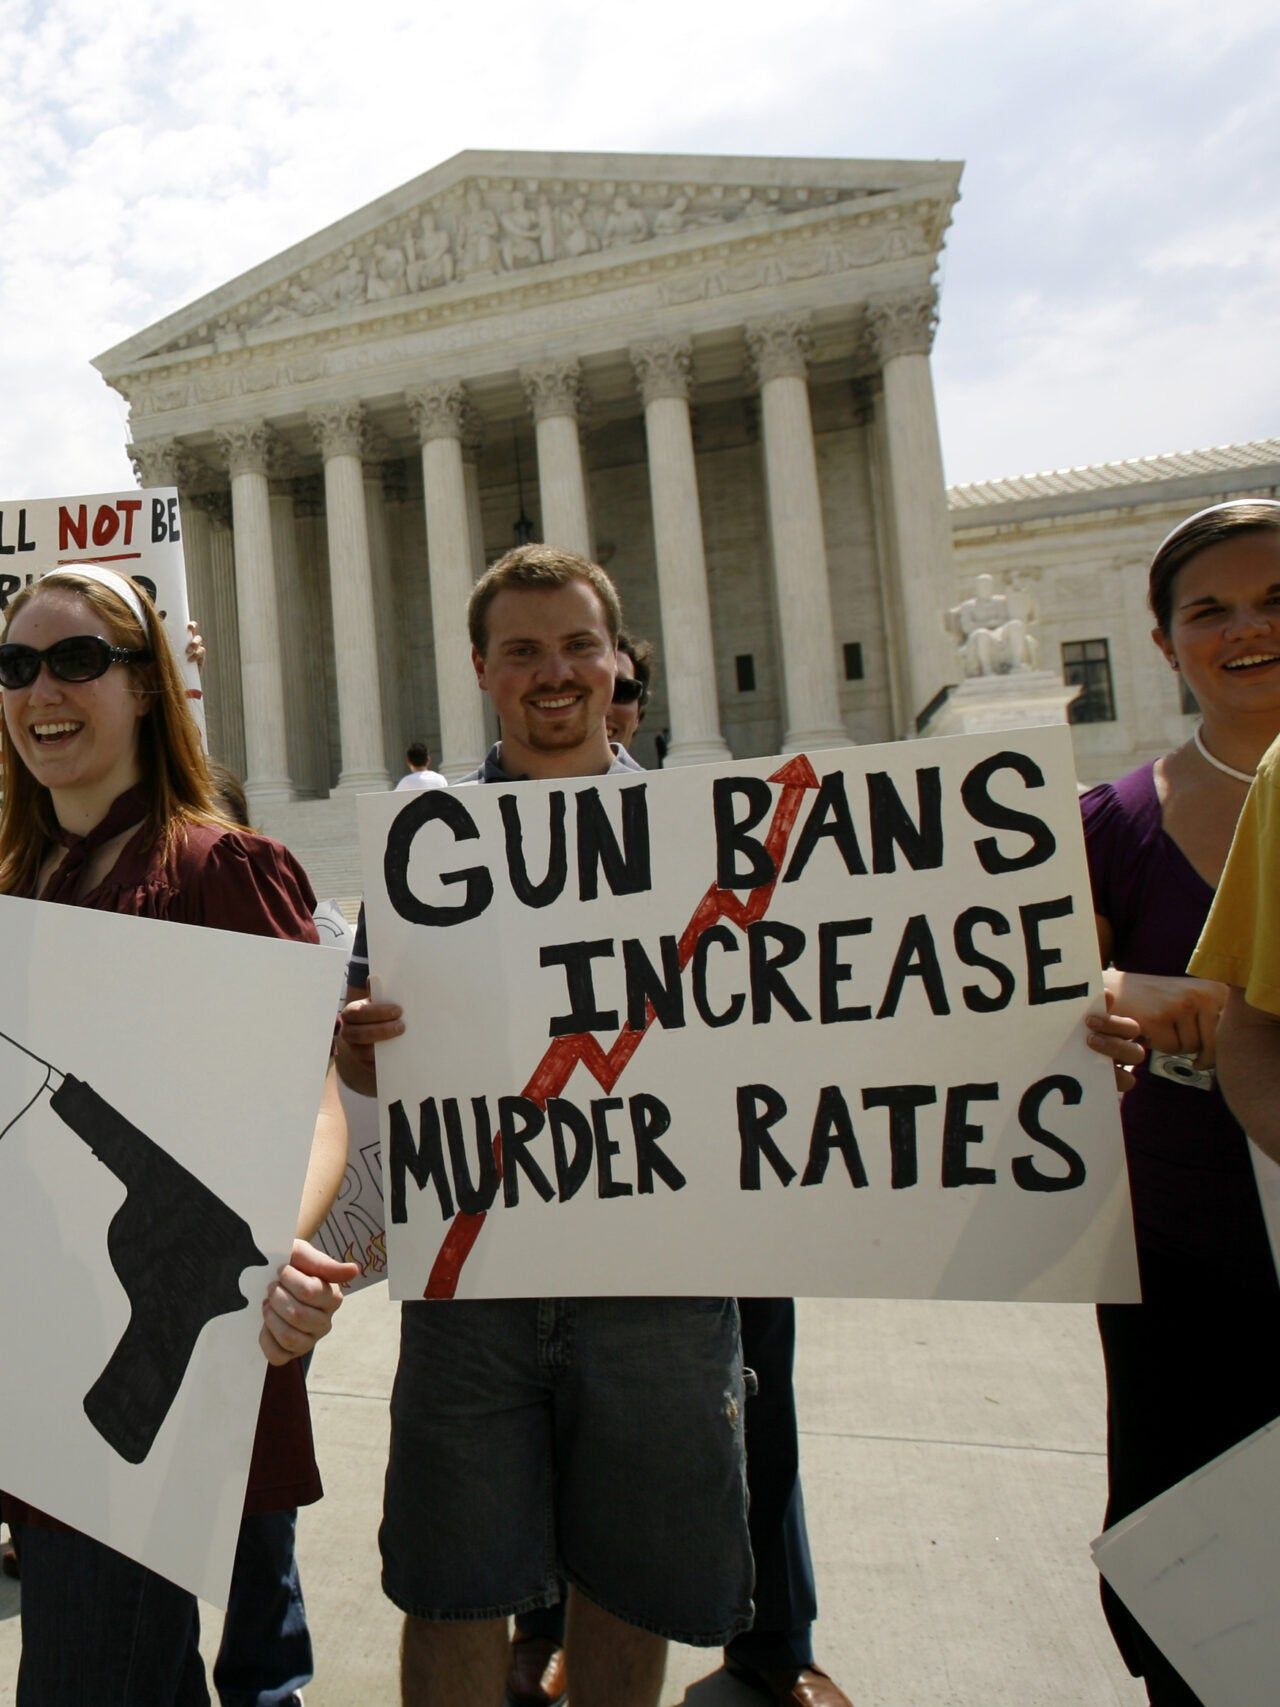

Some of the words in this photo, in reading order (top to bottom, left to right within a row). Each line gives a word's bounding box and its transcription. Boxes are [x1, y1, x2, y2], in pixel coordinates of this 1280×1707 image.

[58, 500, 142, 550] NOT
[151, 497, 180, 543] BE
[383, 785, 652, 928] GUN
[712, 750, 1057, 891] BANS
[539, 895, 1089, 1038] INCREASE
[388, 1092, 687, 1226] MURDER
[736, 1074, 1087, 1194] RATES
